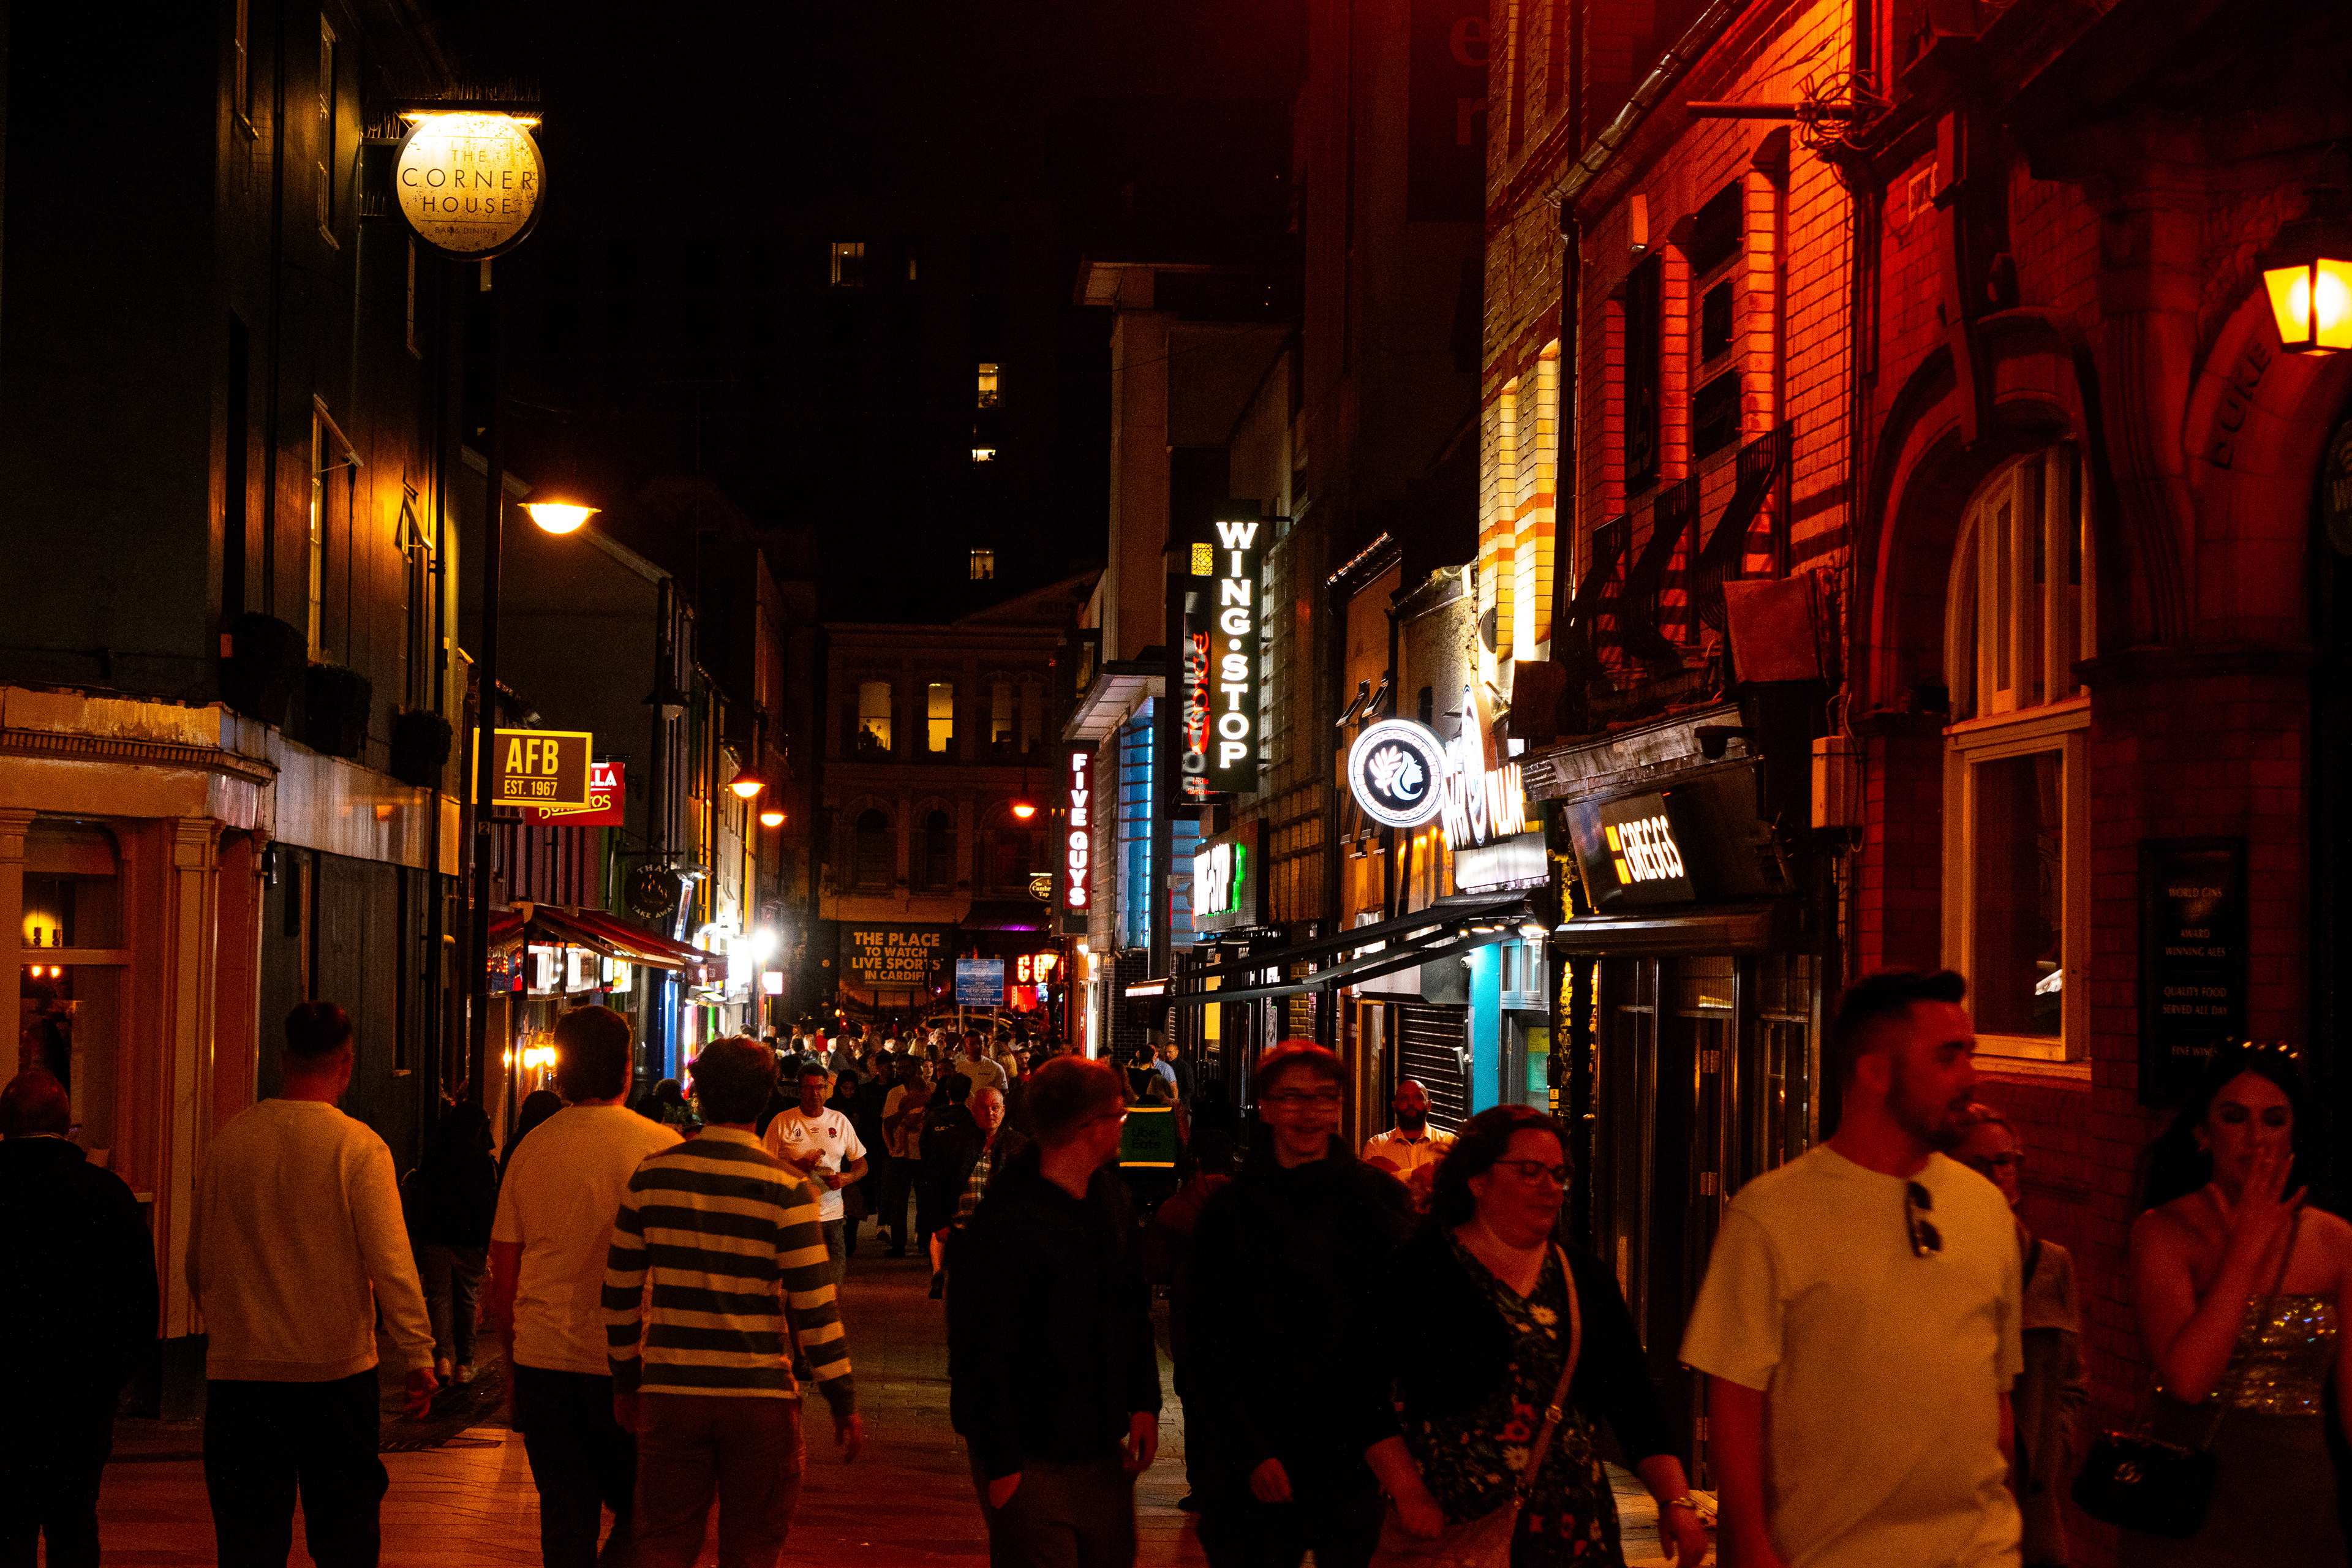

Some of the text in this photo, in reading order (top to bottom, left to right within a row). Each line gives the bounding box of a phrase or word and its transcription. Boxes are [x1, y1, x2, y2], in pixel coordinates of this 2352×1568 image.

[451, 149, 486, 162] THE
[402, 167, 533, 190] CORNER
[423, 196, 512, 214] HOUSE
[2211, 342, 2272, 470] DUKE
[1187, 631, 1210, 755] Spice
[505, 737, 559, 775] AFB
[503, 779, 558, 796] EST. 1967
[1068, 753, 1088, 907] FIVE GUYS
[1618, 815, 1684, 883] GREGGS
[636, 864, 669, 875] THAI
[2168, 888, 2223, 898] WORLD GINS
[631, 902, 675, 918] TAKE AWAY
[853, 932, 940, 947] THE PLACE
[2180, 929, 2211, 938] AWARD
[864, 946, 928, 958] TO WATCH
[2165, 946, 2226, 957] WINNING ALES
[852, 957, 883, 969] LIVE
[864, 970, 877, 980] IN
[2163, 987, 2227, 998] QUALITY FOOD
[2162, 1004, 2229, 1016] SERVED ALL DAY
[2171, 1046, 2190, 1056] FINE
[1132, 1127, 1161, 1138] Uber
[1133, 1139, 1161, 1149] Eats
